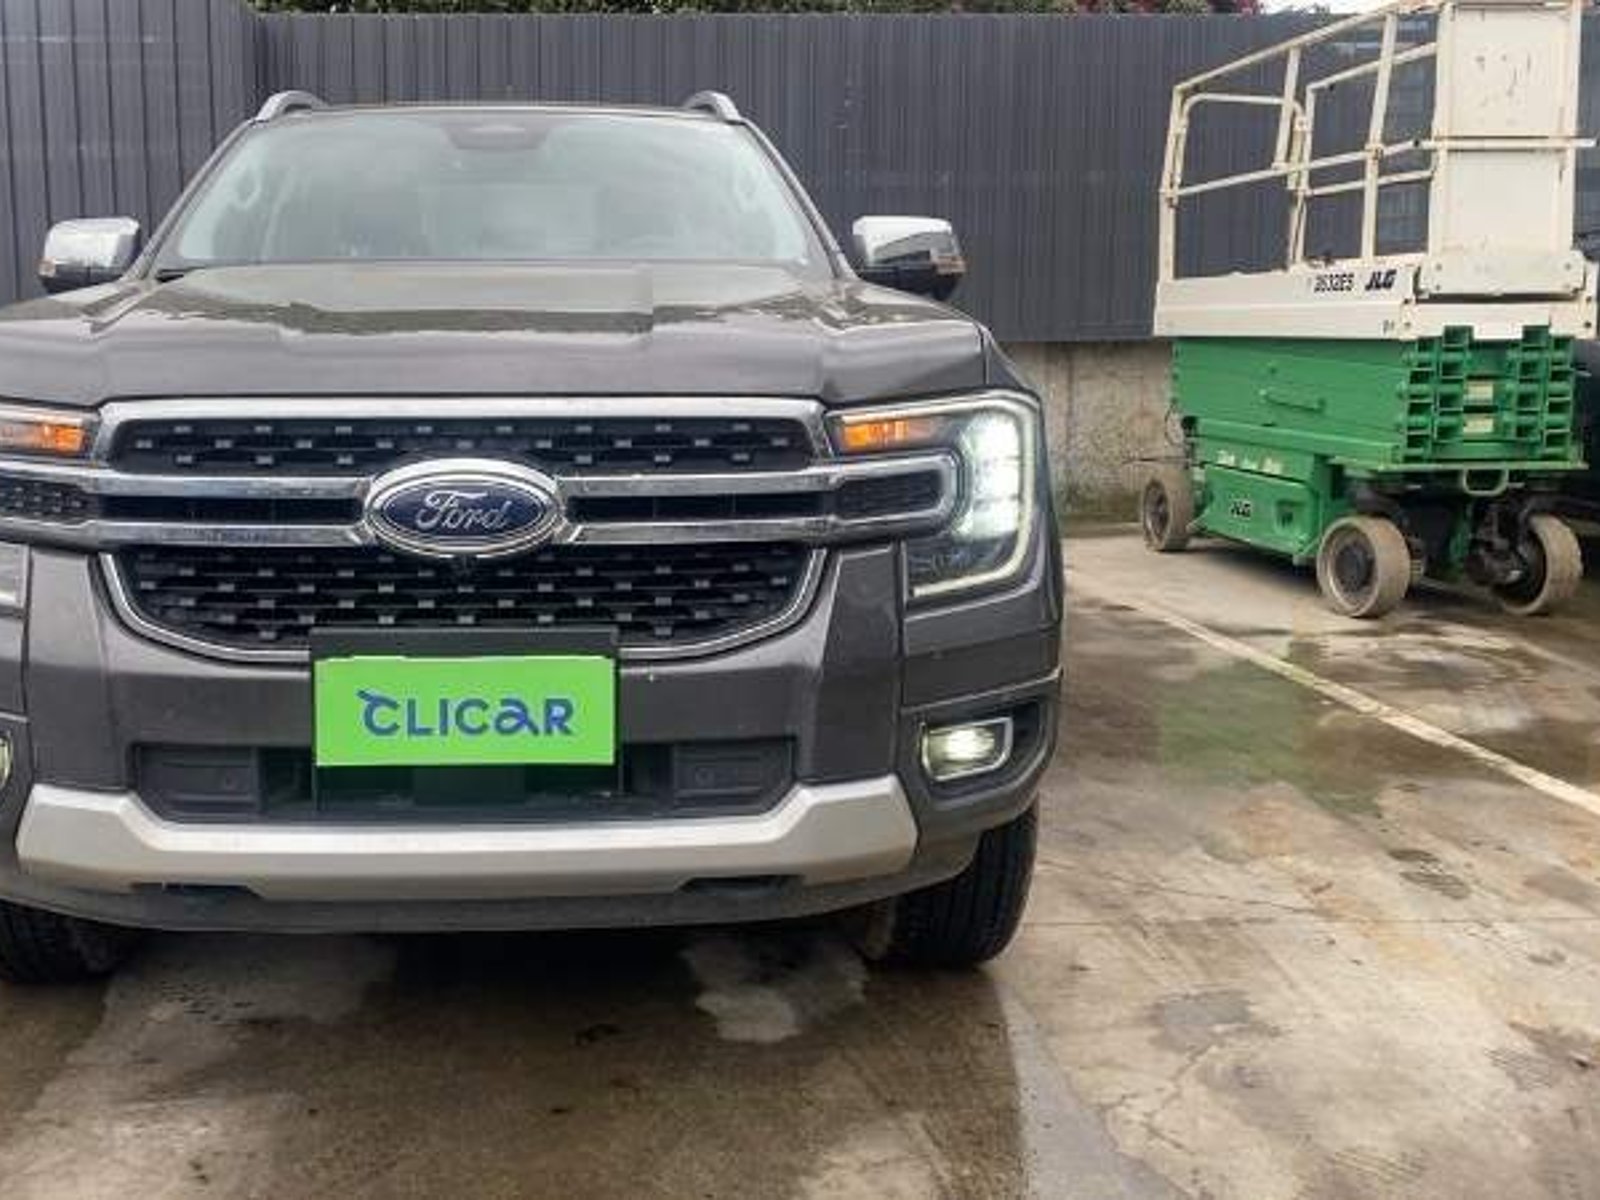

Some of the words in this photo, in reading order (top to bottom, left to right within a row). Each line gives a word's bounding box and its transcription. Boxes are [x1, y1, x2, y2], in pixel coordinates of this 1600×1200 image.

[1365, 268, 1397, 291] JLG
[416, 490, 512, 530] Ford
[357, 688, 575, 737] CLICAR
